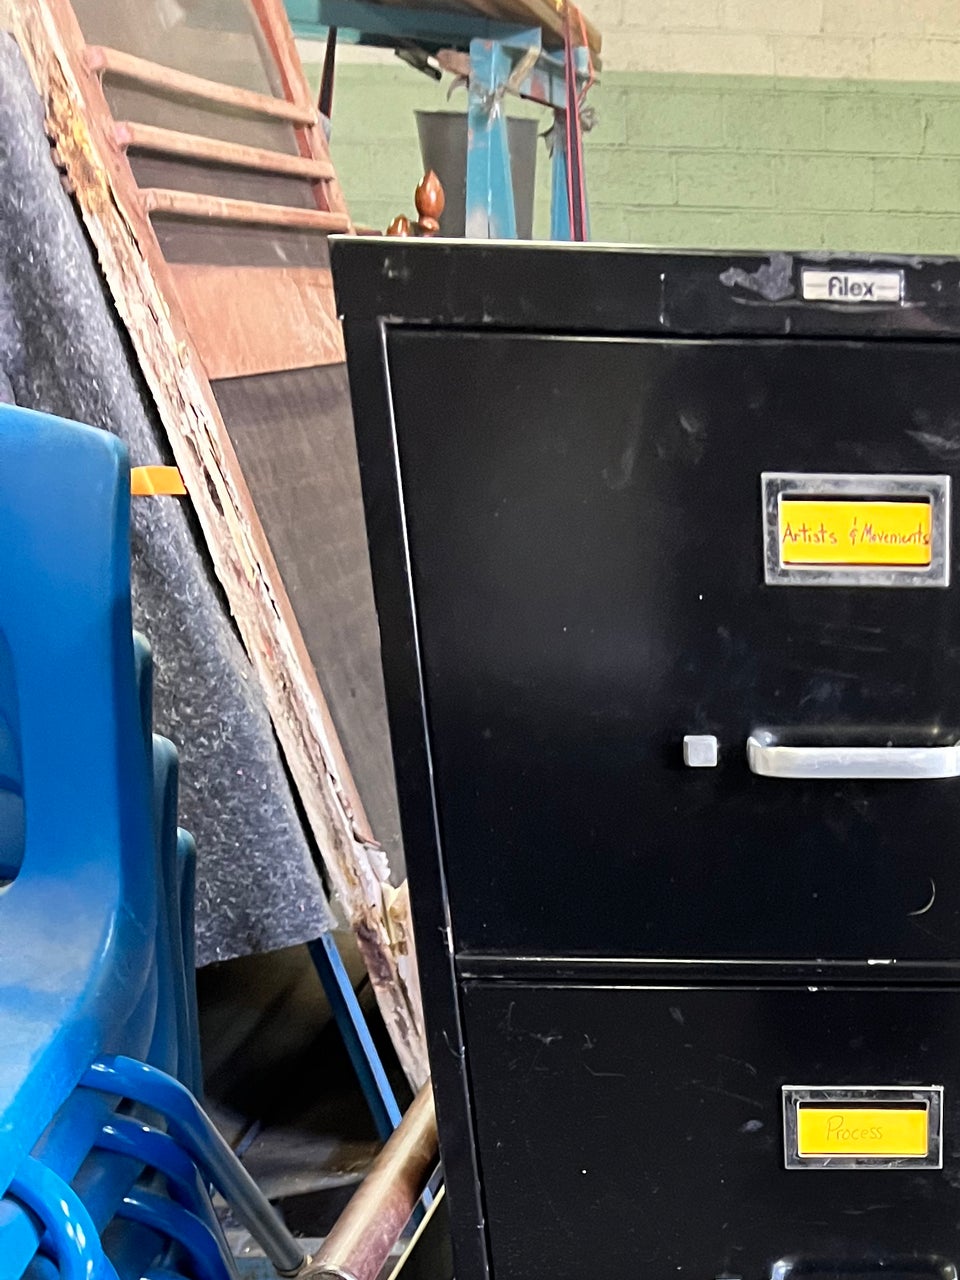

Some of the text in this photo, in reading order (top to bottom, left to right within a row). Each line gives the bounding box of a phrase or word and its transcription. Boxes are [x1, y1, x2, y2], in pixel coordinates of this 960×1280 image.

[782, 522, 838, 545] Artists
[861, 522, 932, 546] Movements
[827, 1115, 884, 1141] Process
